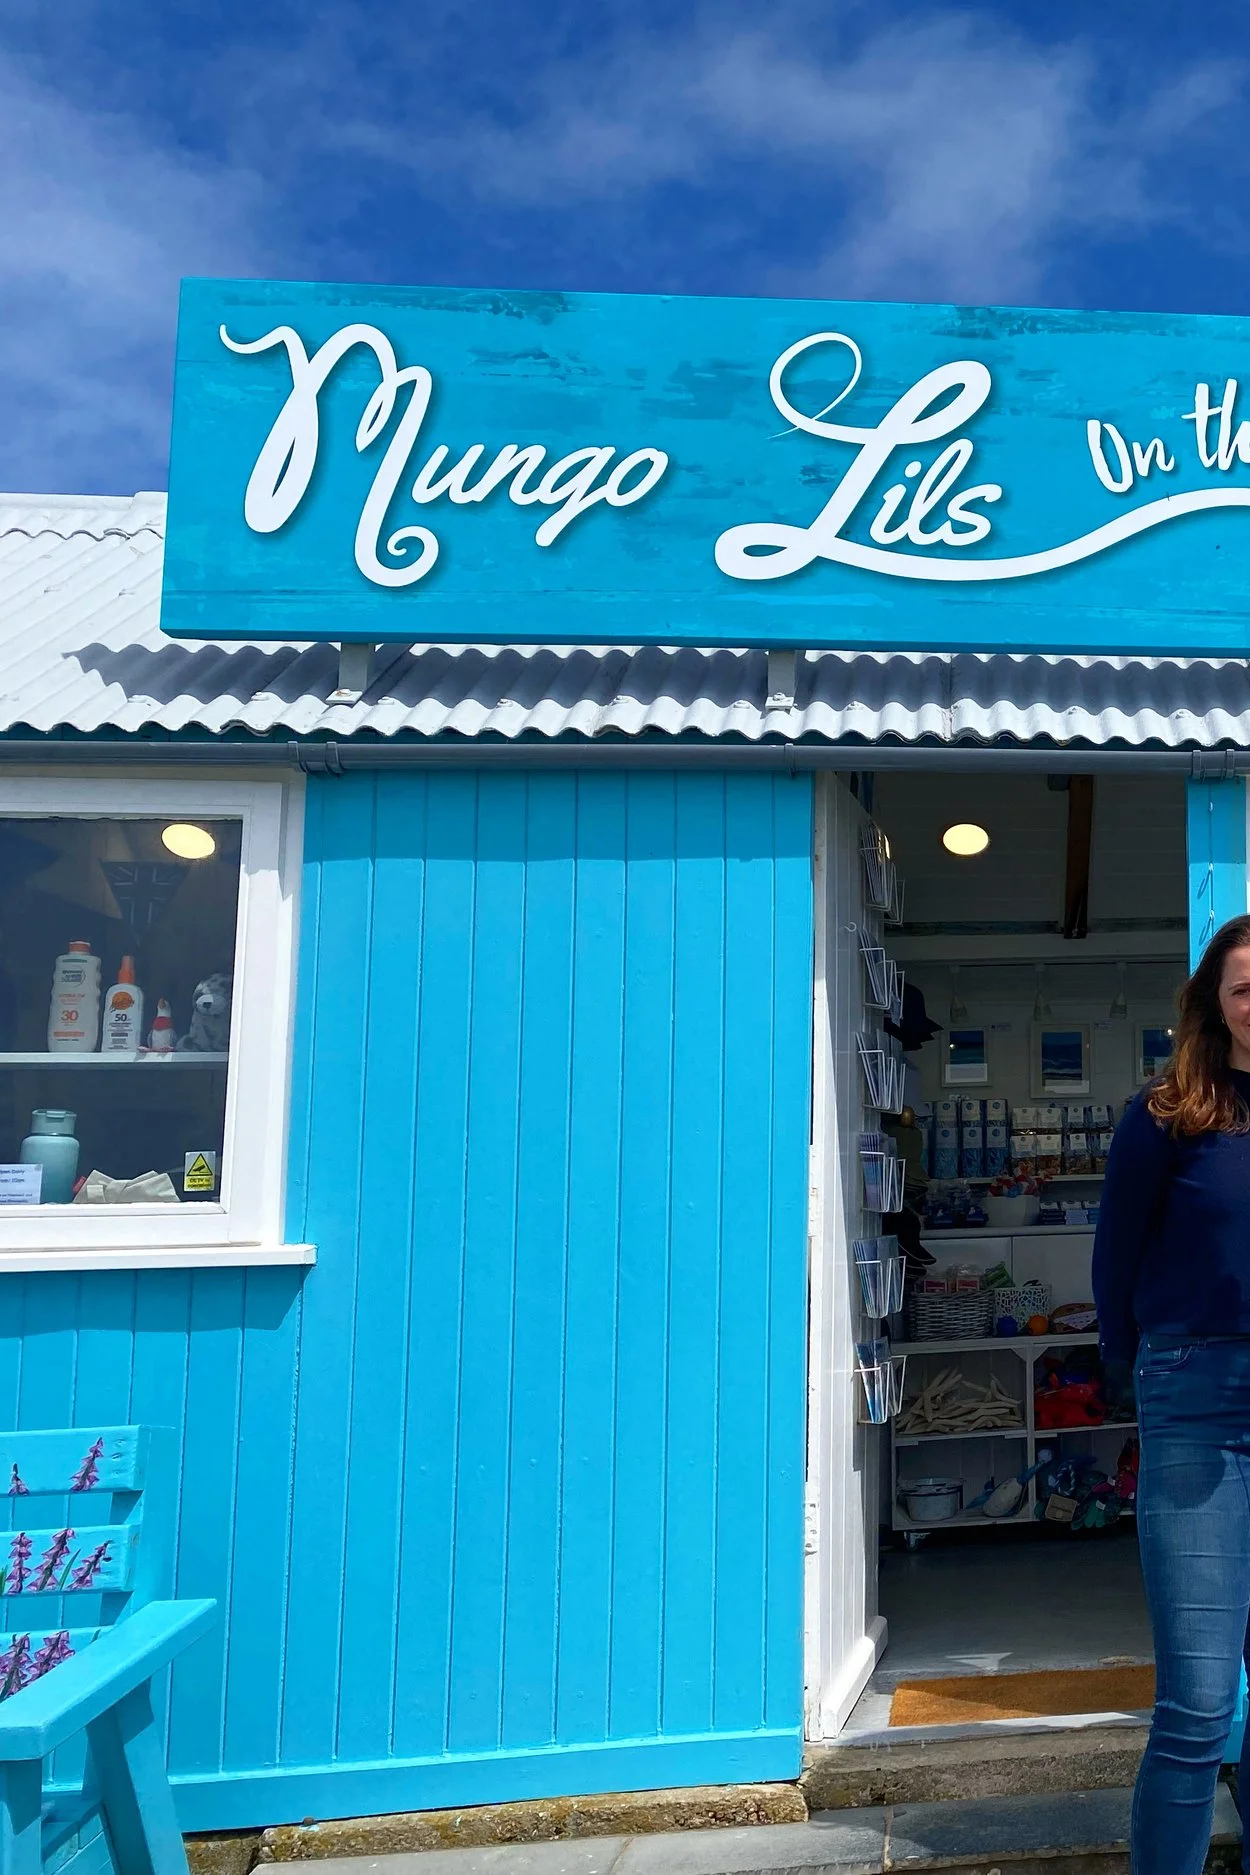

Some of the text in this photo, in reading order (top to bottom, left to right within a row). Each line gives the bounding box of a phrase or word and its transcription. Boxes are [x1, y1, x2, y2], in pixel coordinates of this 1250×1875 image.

[220, 323, 1003, 587] Mungo Lils
[1086, 418, 1175, 493] On
[61, 1010, 79, 1021] 30
[115, 1013, 128, 1022] 50
